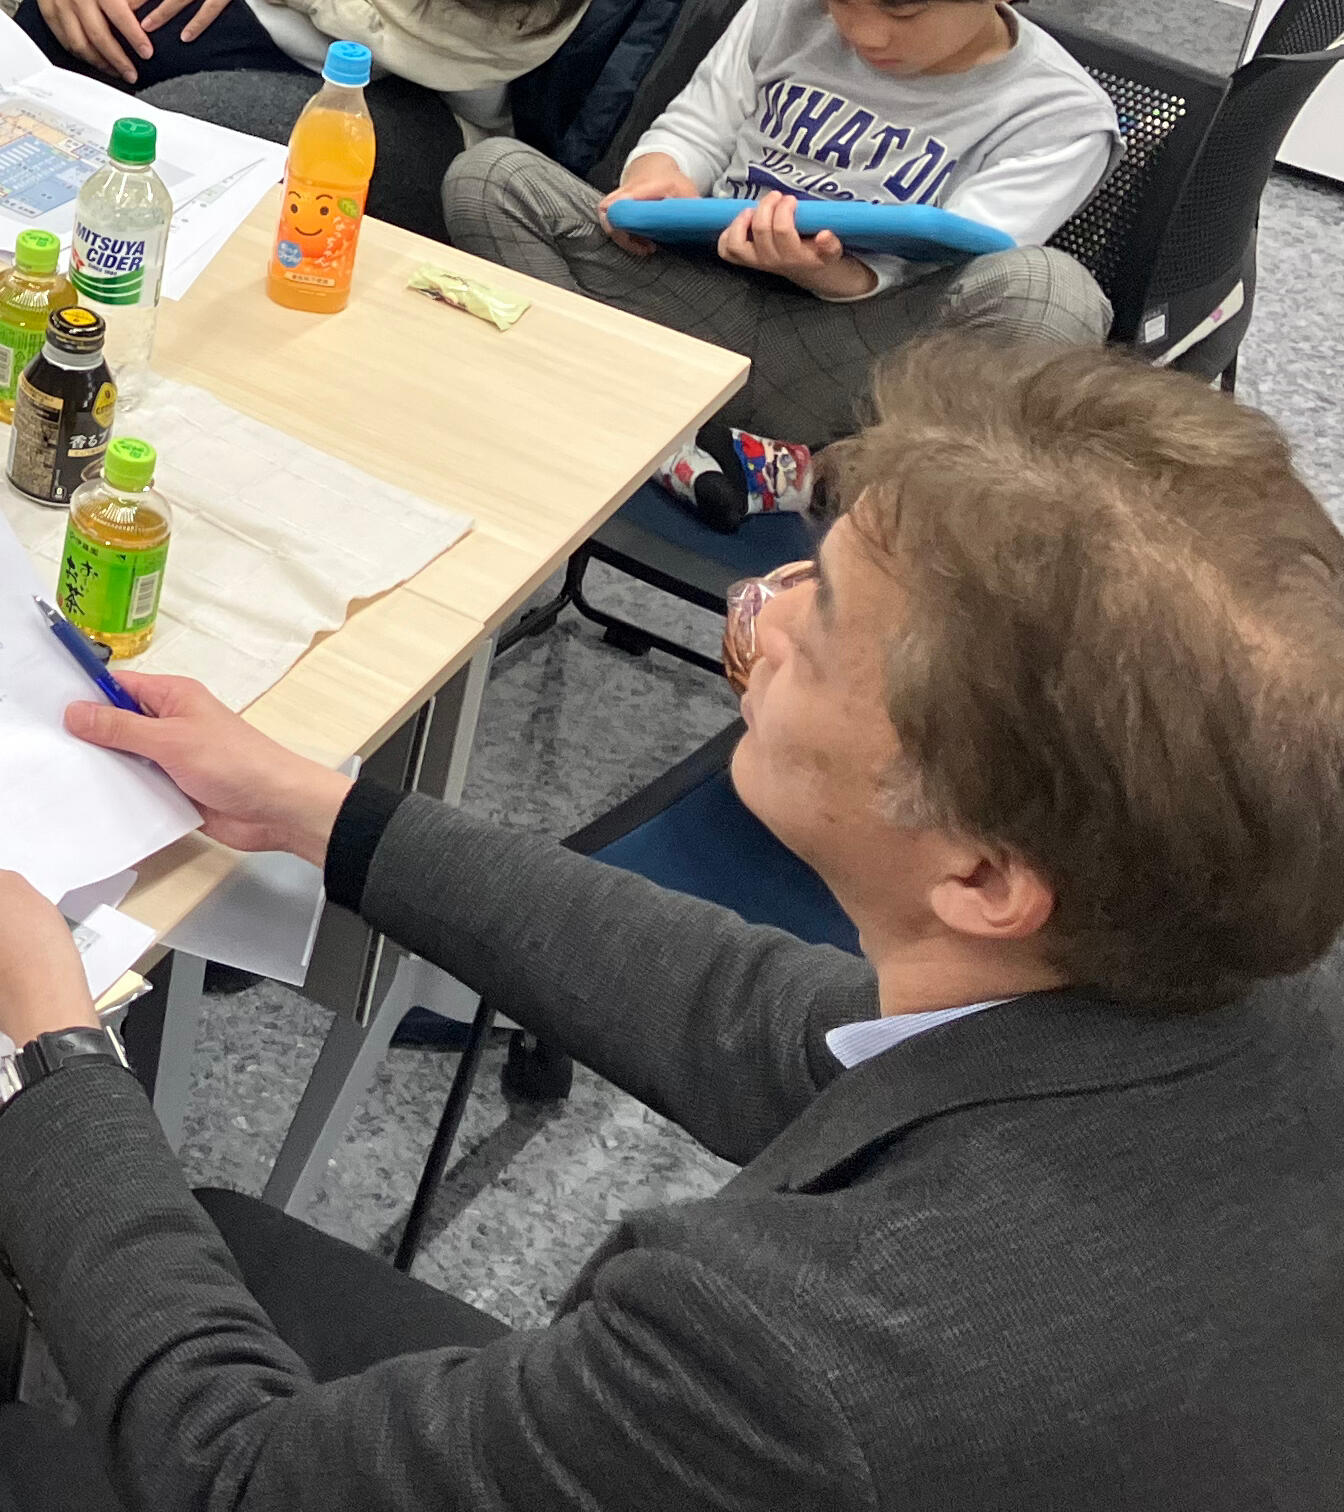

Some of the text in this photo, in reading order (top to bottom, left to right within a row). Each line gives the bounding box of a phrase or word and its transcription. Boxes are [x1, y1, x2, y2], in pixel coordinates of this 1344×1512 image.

[759, 80, 912, 171] WHAT
[76, 221, 146, 256] MITSUYA
[86, 247, 143, 272] CIDER
[64, 555, 87, 616] お茶
